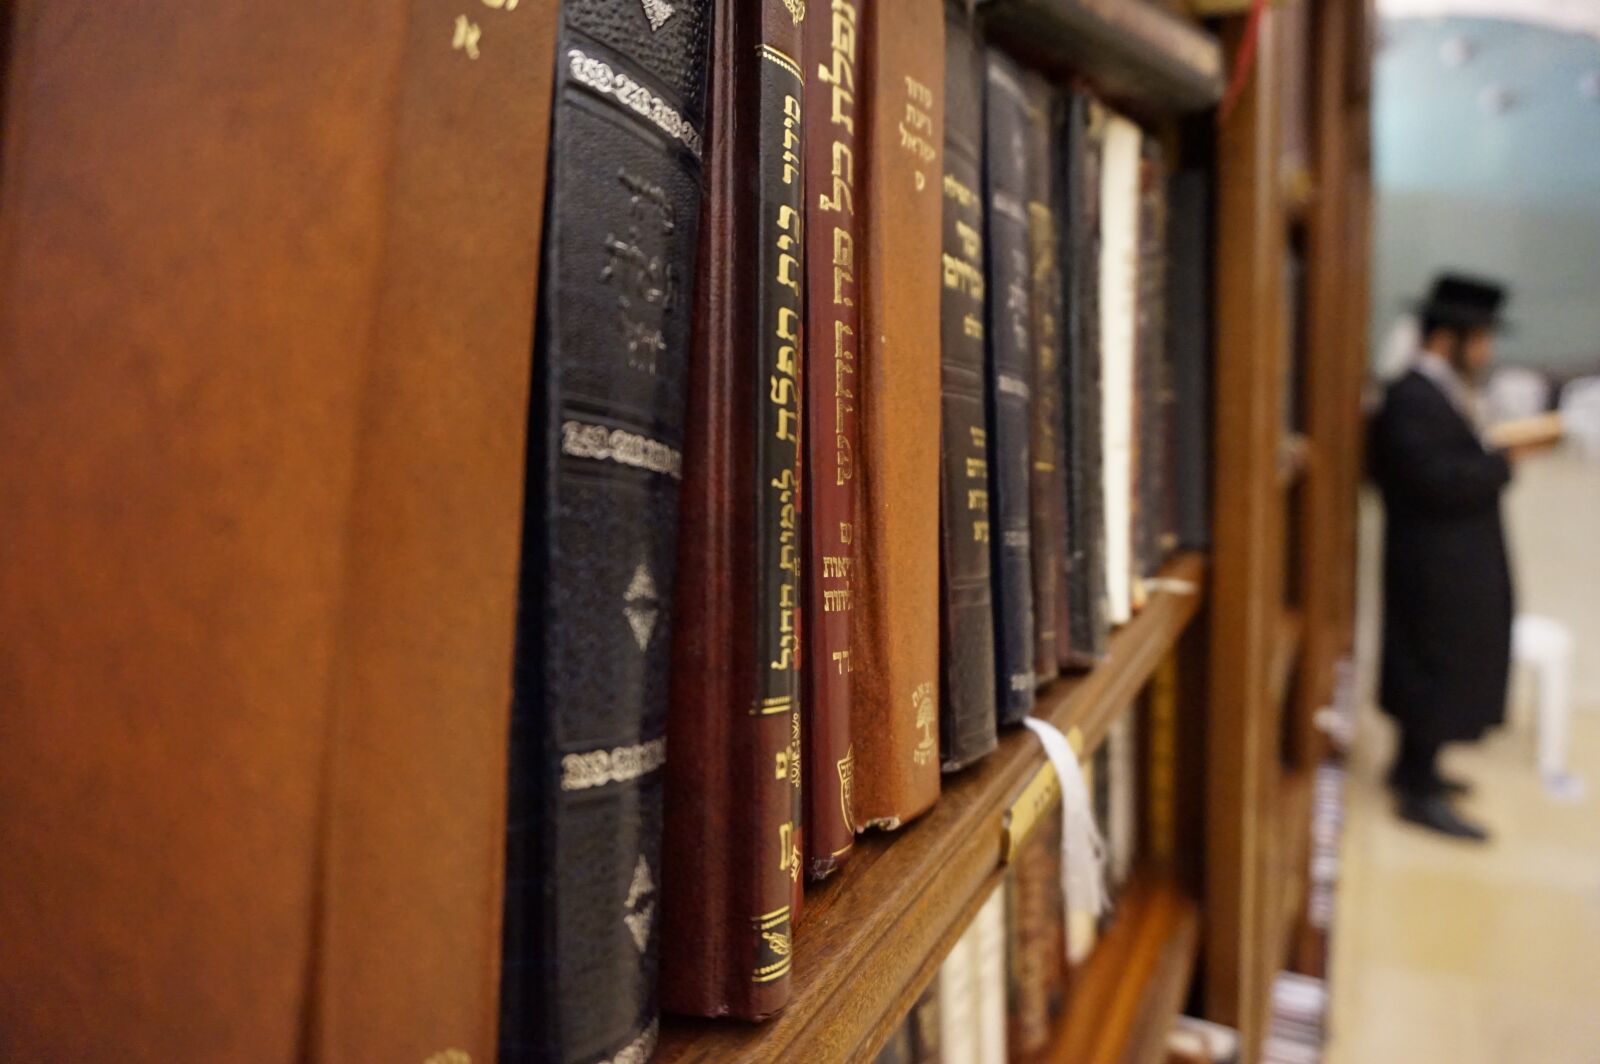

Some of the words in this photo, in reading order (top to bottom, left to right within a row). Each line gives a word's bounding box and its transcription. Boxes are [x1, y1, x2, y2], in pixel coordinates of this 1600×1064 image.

[453, 13, 481, 60] א
[782, 94, 801, 184] סידור
[820, 141, 854, 216] כל
[776, 204, 800, 297] בית
[832, 226, 854, 306] פה
[770, 306, 801, 443] תפלה
[771, 469, 799, 572] לימות
[771, 584, 794, 671] החול
